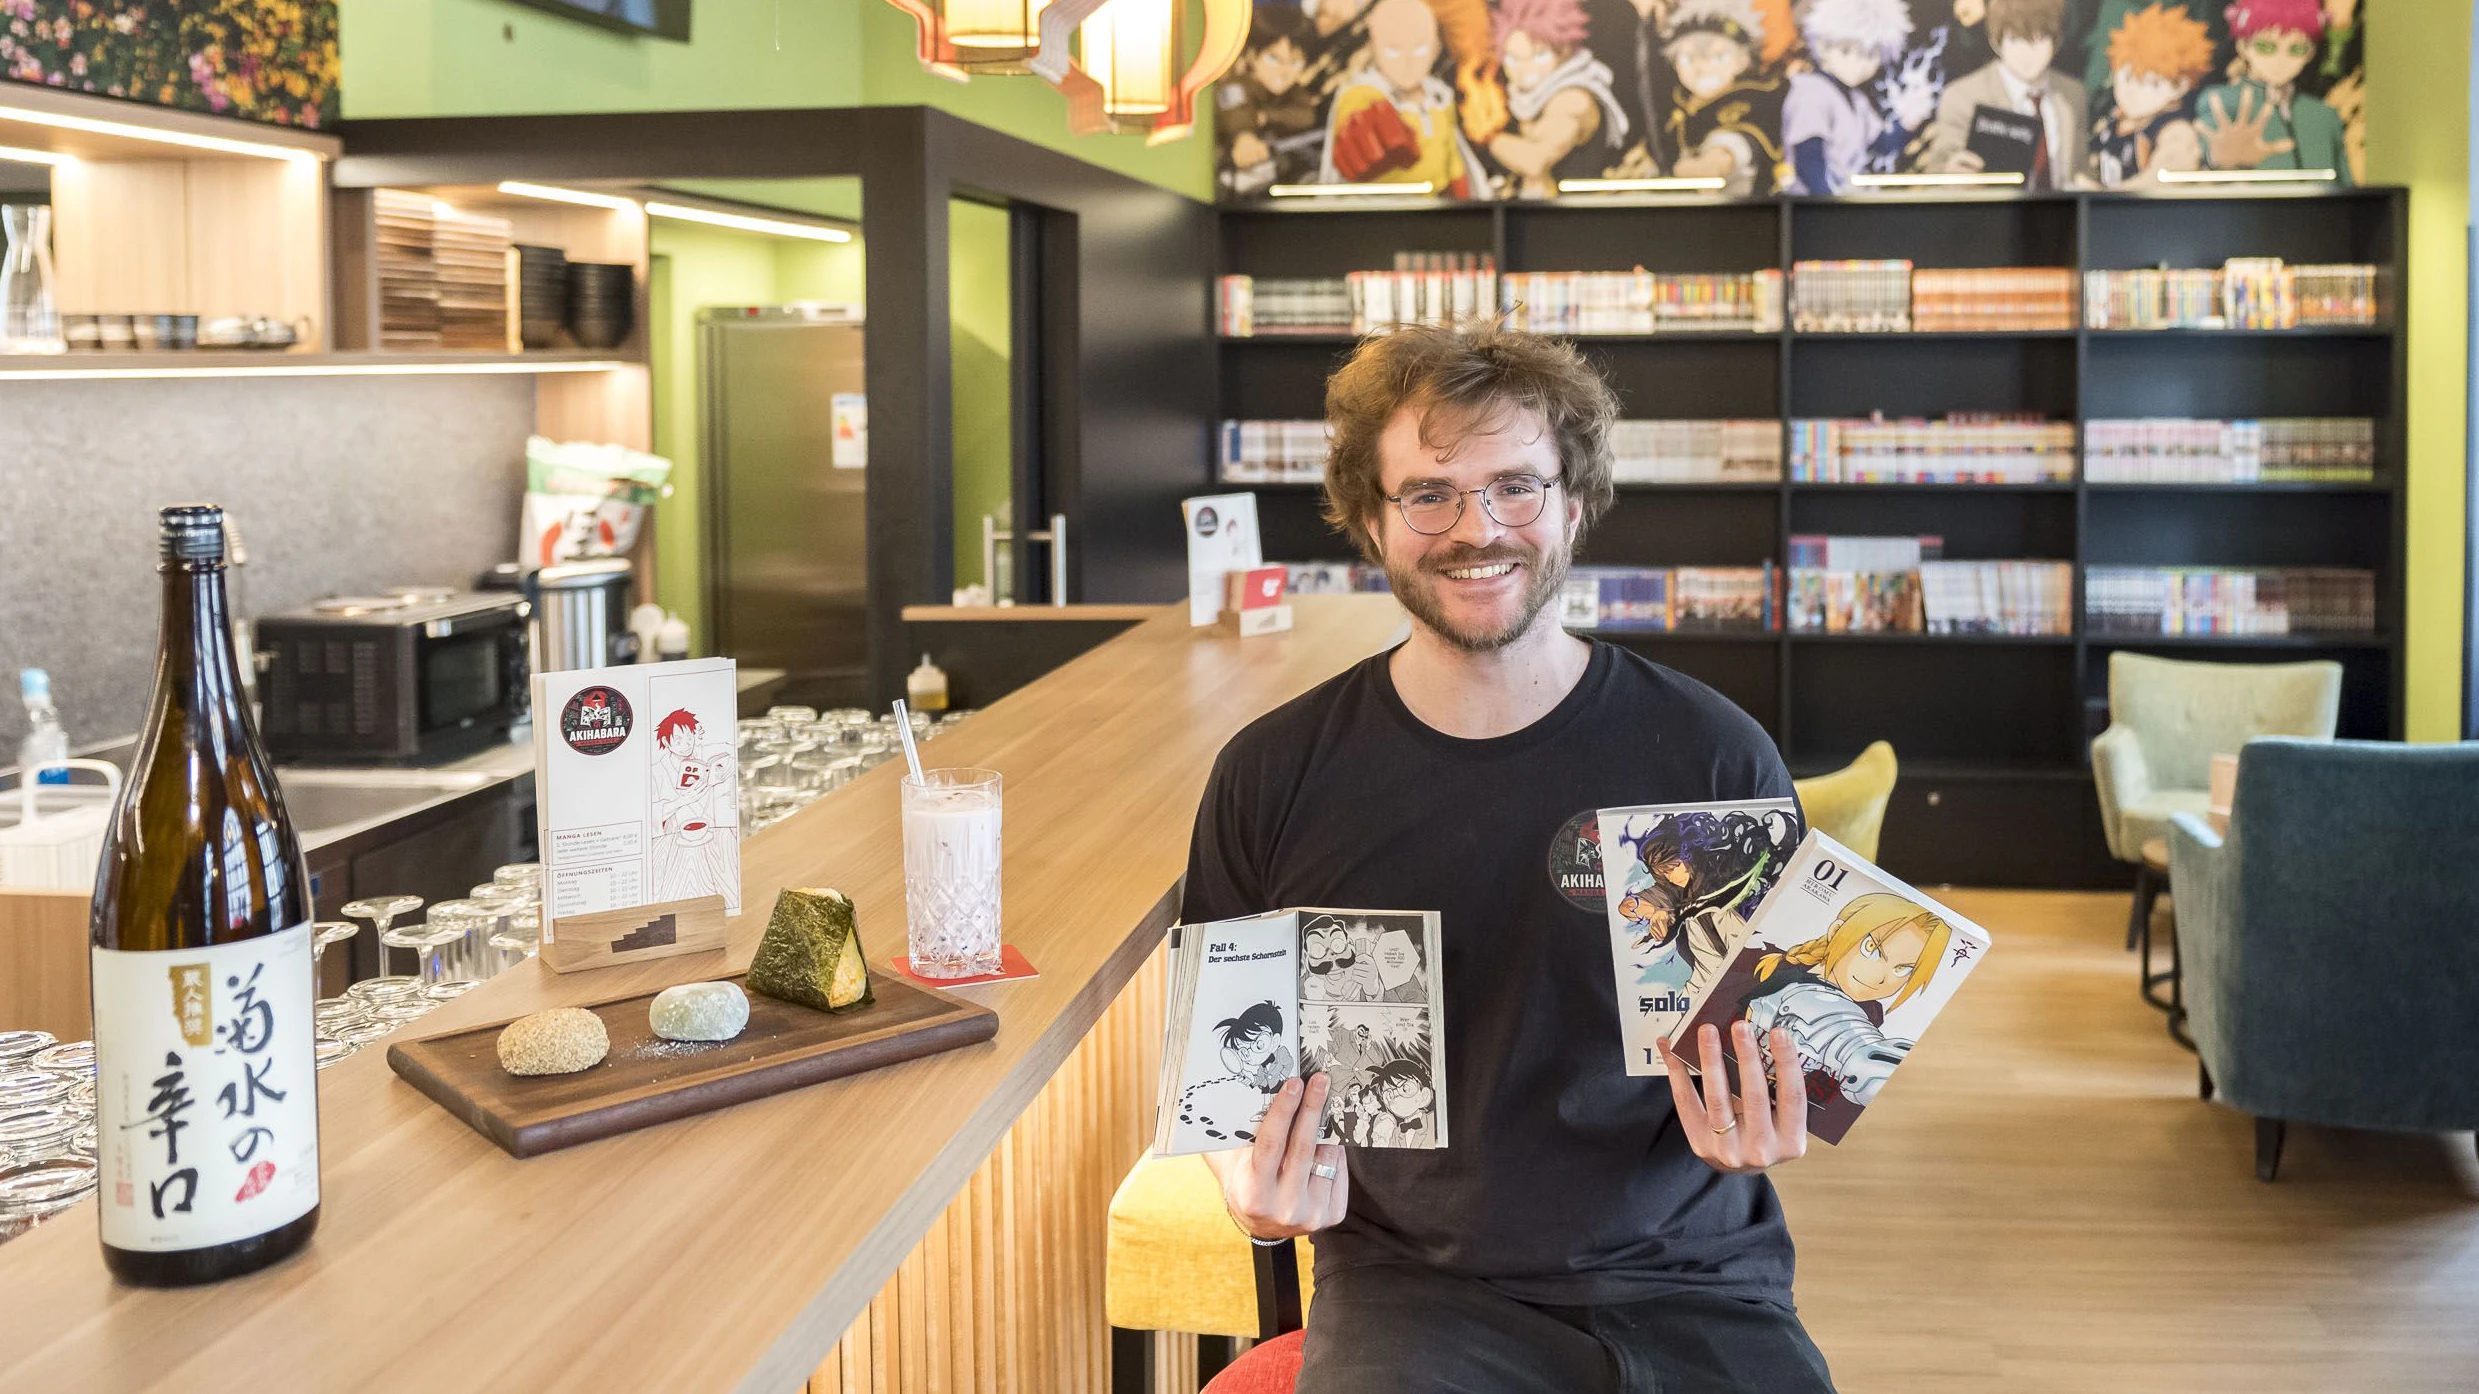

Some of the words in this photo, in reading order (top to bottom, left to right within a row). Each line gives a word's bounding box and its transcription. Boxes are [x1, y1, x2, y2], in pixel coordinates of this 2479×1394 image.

[569, 726, 626, 742] AKIHABARA
[556, 867, 613, 879] ÖFFNUNGSZEITEN
[1813, 859, 1849, 891] 01
[1803, 883, 1830, 902] ARAKAWA
[1805, 879, 1835, 897] HIROMU
[1209, 943, 1227, 952] Fall
[1228, 942, 1237, 952] 4:
[1208, 955, 1222, 963] Der
[1223, 954, 1250, 962] sechste
[214, 962, 287, 1163] 菊水の
[1643, 1048, 1652, 1065] 1
[119, 1050, 199, 1220] 辛口
